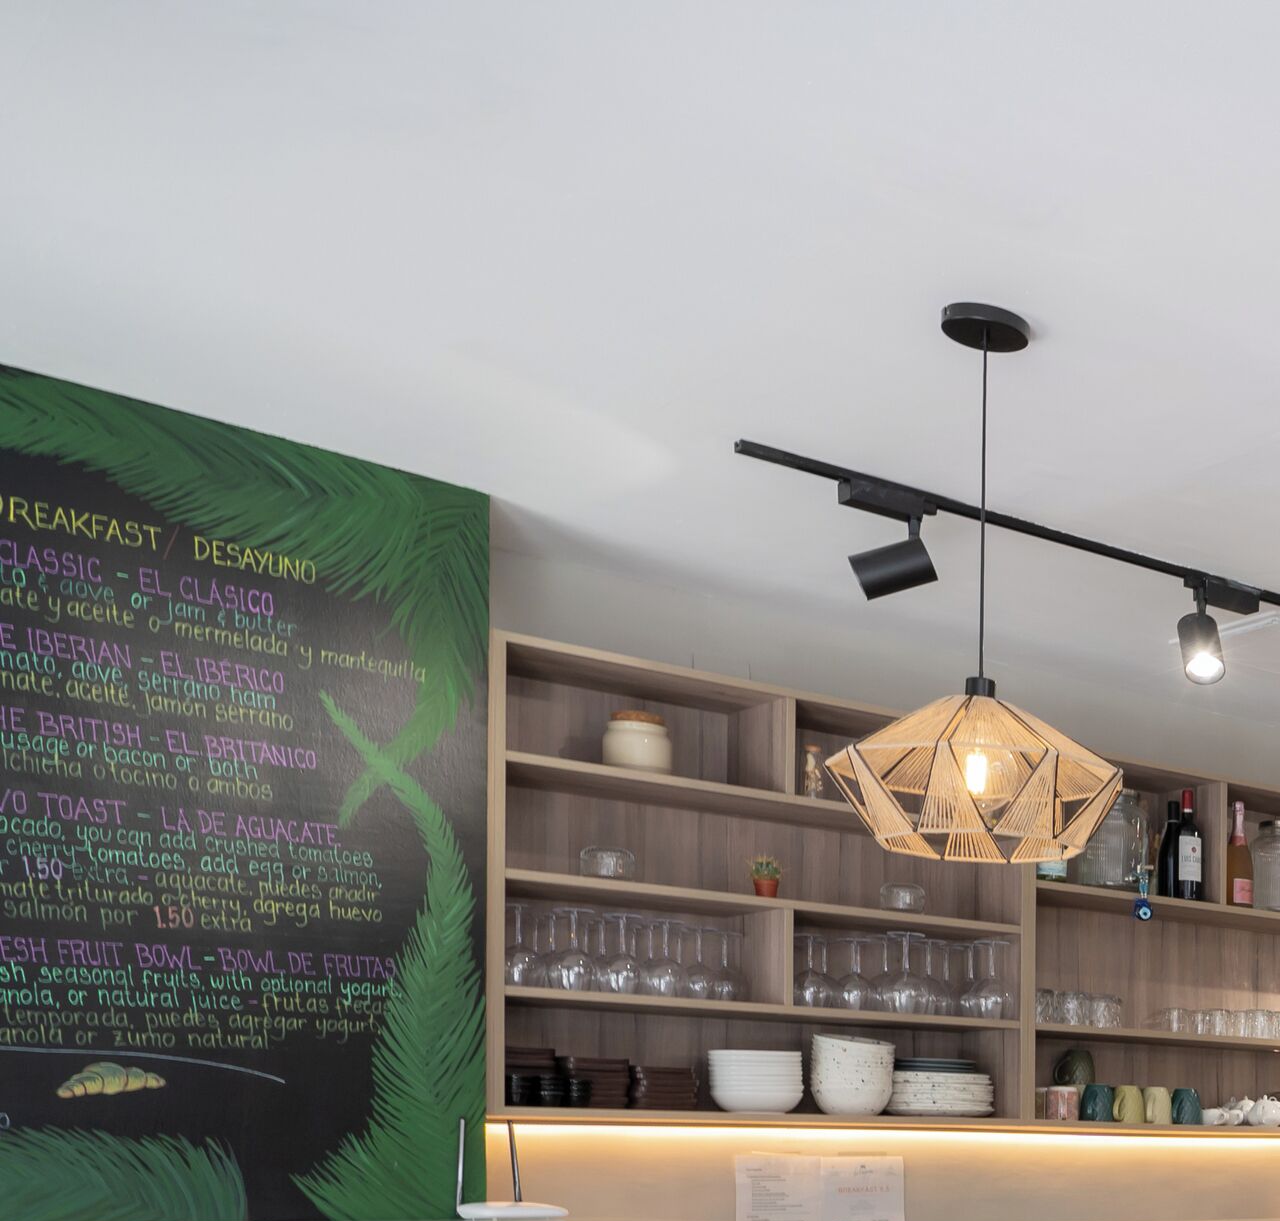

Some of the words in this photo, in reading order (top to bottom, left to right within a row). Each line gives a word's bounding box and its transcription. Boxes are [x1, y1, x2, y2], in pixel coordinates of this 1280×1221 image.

[0, 496, 161, 551] REAKFAST
[193, 535, 317, 585] DESAYUNO
[0, 539, 102, 584] CLASSIC
[139, 566, 172, 598] EL
[60, 577, 114, 603] aove
[131, 592, 152, 610] or
[160, 598, 206, 625] jam
[234, 608, 298, 639] butter
[27, 626, 131, 669] IBERIAN
[160, 650, 193, 681] EL
[45, 595, 61, 624] y
[67, 601, 135, 629] aceite
[149, 615, 160, 633] o
[174, 621, 288, 657] mermelada
[299, 645, 312, 670] y
[320, 649, 426, 683] mantequilla
[138, 671, 221, 701] serrano
[229, 683, 276, 710] ham
[36, 710, 143, 749] BRITISH
[165, 729, 200, 757] EL
[216, 701, 294, 732] serrano
[77, 741, 98, 758] or
[103, 740, 167, 770] bacon
[176, 753, 196, 773] or
[209, 751, 259, 781] both
[94, 763, 106, 780] o
[111, 763, 178, 791] tocino
[189, 773, 200, 792] o
[207, 773, 275, 802] ambos
[37, 791, 127, 826] TOAST
[162, 805, 193, 833] LA
[197, 809, 227, 838] DE
[6, 838, 80, 869] cherry
[200, 853, 239, 875] add
[249, 861, 284, 885] egg
[291, 864, 311, 879] or
[77, 824, 112, 851] you
[117, 829, 152, 848] can
[160, 830, 197, 852] add
[205, 835, 281, 860] crushed
[289, 840, 374, 869] tomatoes
[22, 855, 63, 881] 1.50
[259, 880, 322, 902] puedes
[56, 878, 153, 906] triturado
[253, 896, 320, 928] agrega
[329, 899, 383, 923] huevo
[100, 904, 139, 931] por
[201, 910, 252, 933] extra
[38, 963, 135, 988] seasonal
[211, 970, 253, 992] with
[260, 971, 332, 997] optional
[58, 939, 123, 967] FRUIT
[135, 943, 202, 972] BOWL
[288, 952, 316, 976] DE
[323, 953, 397, 979] FRUTAS
[68, 988, 88, 1006] or
[98, 984, 181, 1010] natural
[190, 989, 245, 1015] juice
[262, 992, 328, 1017] frutas
[76, 1029, 98, 1046] or
[114, 1028, 176, 1048] zumo
[188, 1027, 269, 1050] natural
[146, 1006, 219, 1036] puedes
[229, 1010, 308, 1042] agregar
